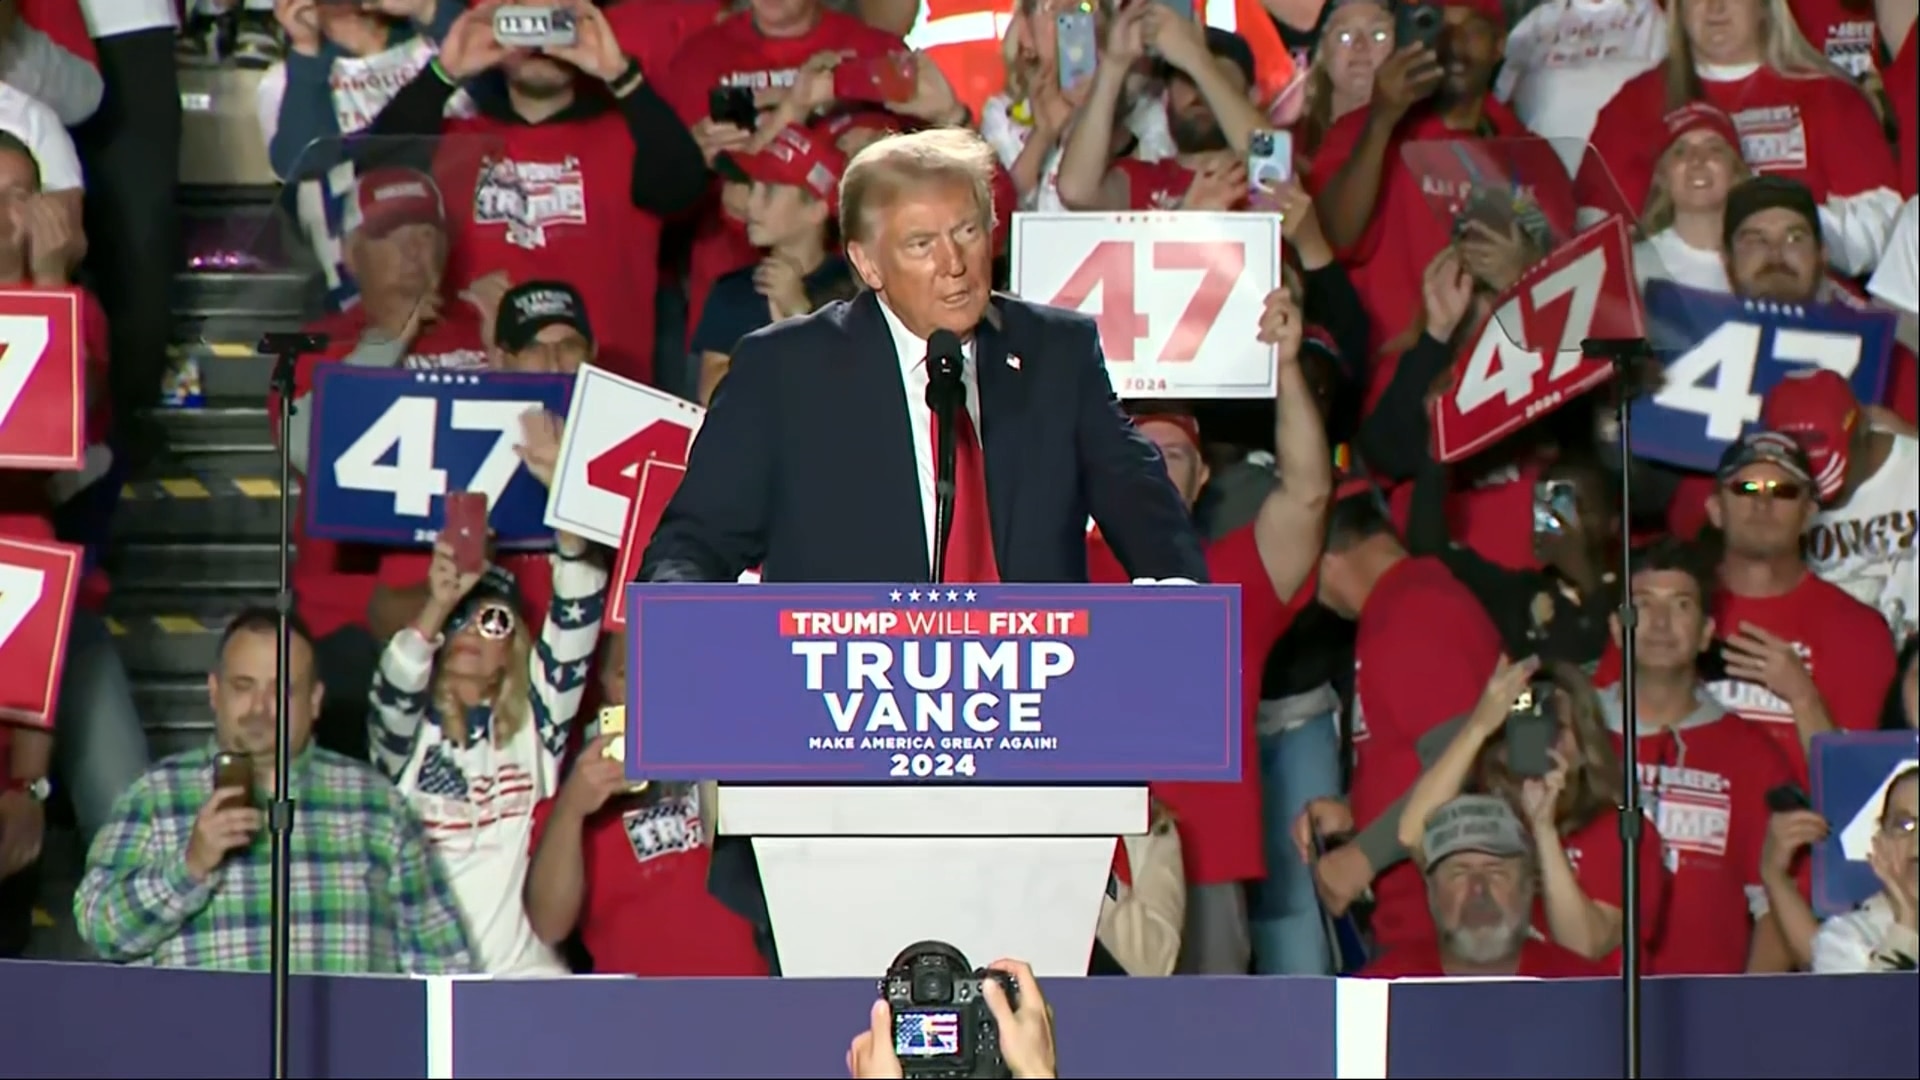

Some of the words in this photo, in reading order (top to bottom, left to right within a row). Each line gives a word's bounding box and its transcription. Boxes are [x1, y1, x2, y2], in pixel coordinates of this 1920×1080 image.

[1048, 240, 1246, 363] 47
[1455, 245, 1608, 416] 47
[1122, 377, 1168, 391] 2024
[1653, 320, 1863, 441] 47
[333, 395, 544, 518] 47
[413, 528, 440, 542] 20
[1808, 509, 1918, 564] ONEY
[792, 612, 898, 635] TRUMP
[906, 612, 979, 634] WILL
[990, 612, 1037, 634] FIX
[1047, 612, 1075, 634] IT
[792, 641, 1075, 691] TRUMP
[823, 692, 1042, 733] VANCE
[809, 737, 855, 750] MAKE
[860, 737, 935, 750] AMERICA
[941, 737, 994, 750] GREAT
[1000, 737, 1057, 750] AGAIN!
[890, 753, 976, 777] 2024
